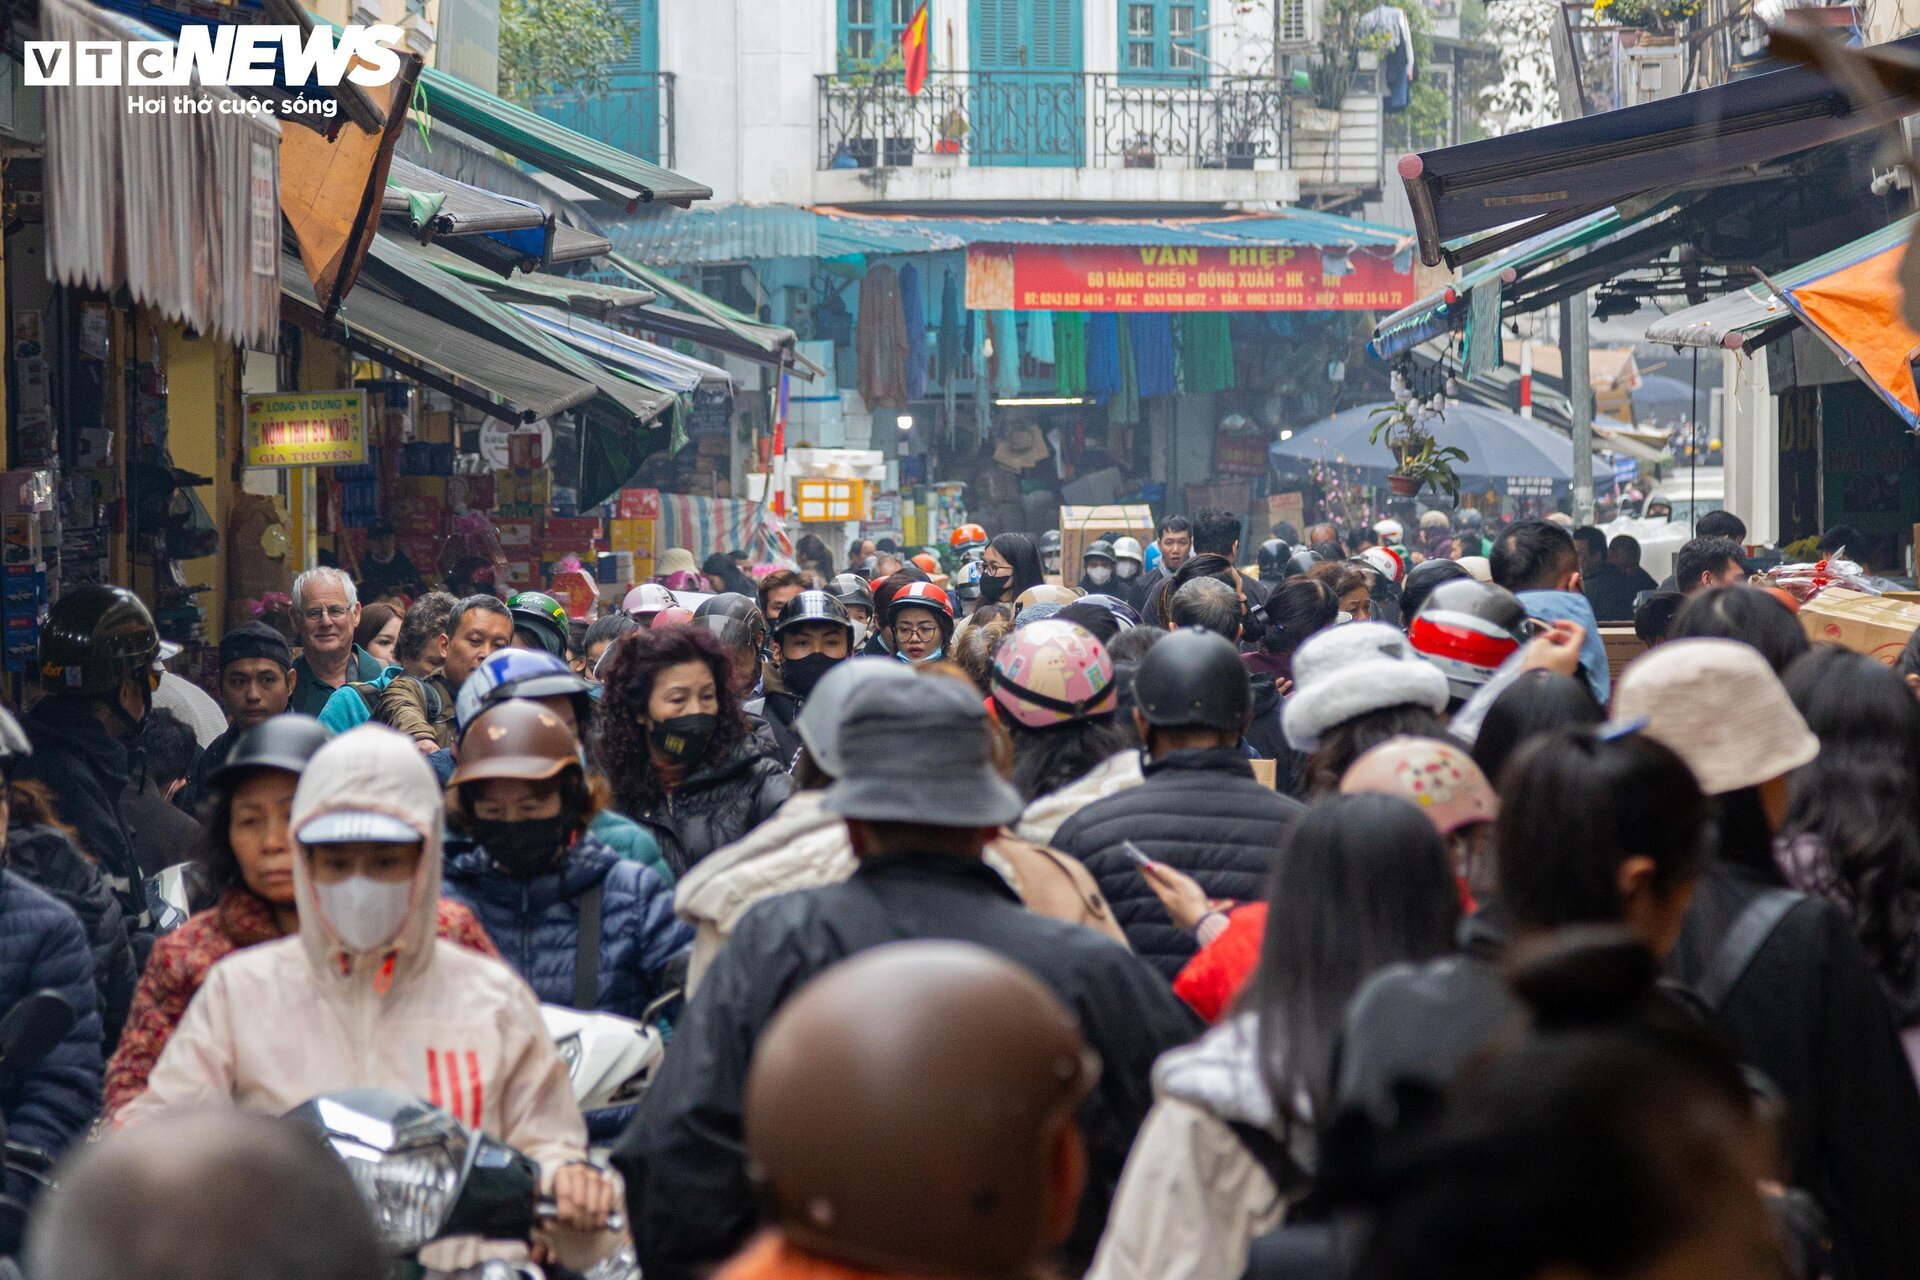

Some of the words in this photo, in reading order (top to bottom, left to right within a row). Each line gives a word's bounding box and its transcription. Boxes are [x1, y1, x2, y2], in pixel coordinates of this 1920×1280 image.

[1141, 244, 1198, 266] VÂN
[1230, 246, 1295, 269] HIỆP
[1107, 267, 1144, 288] HÀNG
[1238, 267, 1274, 288] XUÂN
[1285, 271, 1304, 288] HK
[267, 401, 296, 412] LONG
[288, 418, 310, 449] THỊT
[259, 453, 286, 463] GIA
